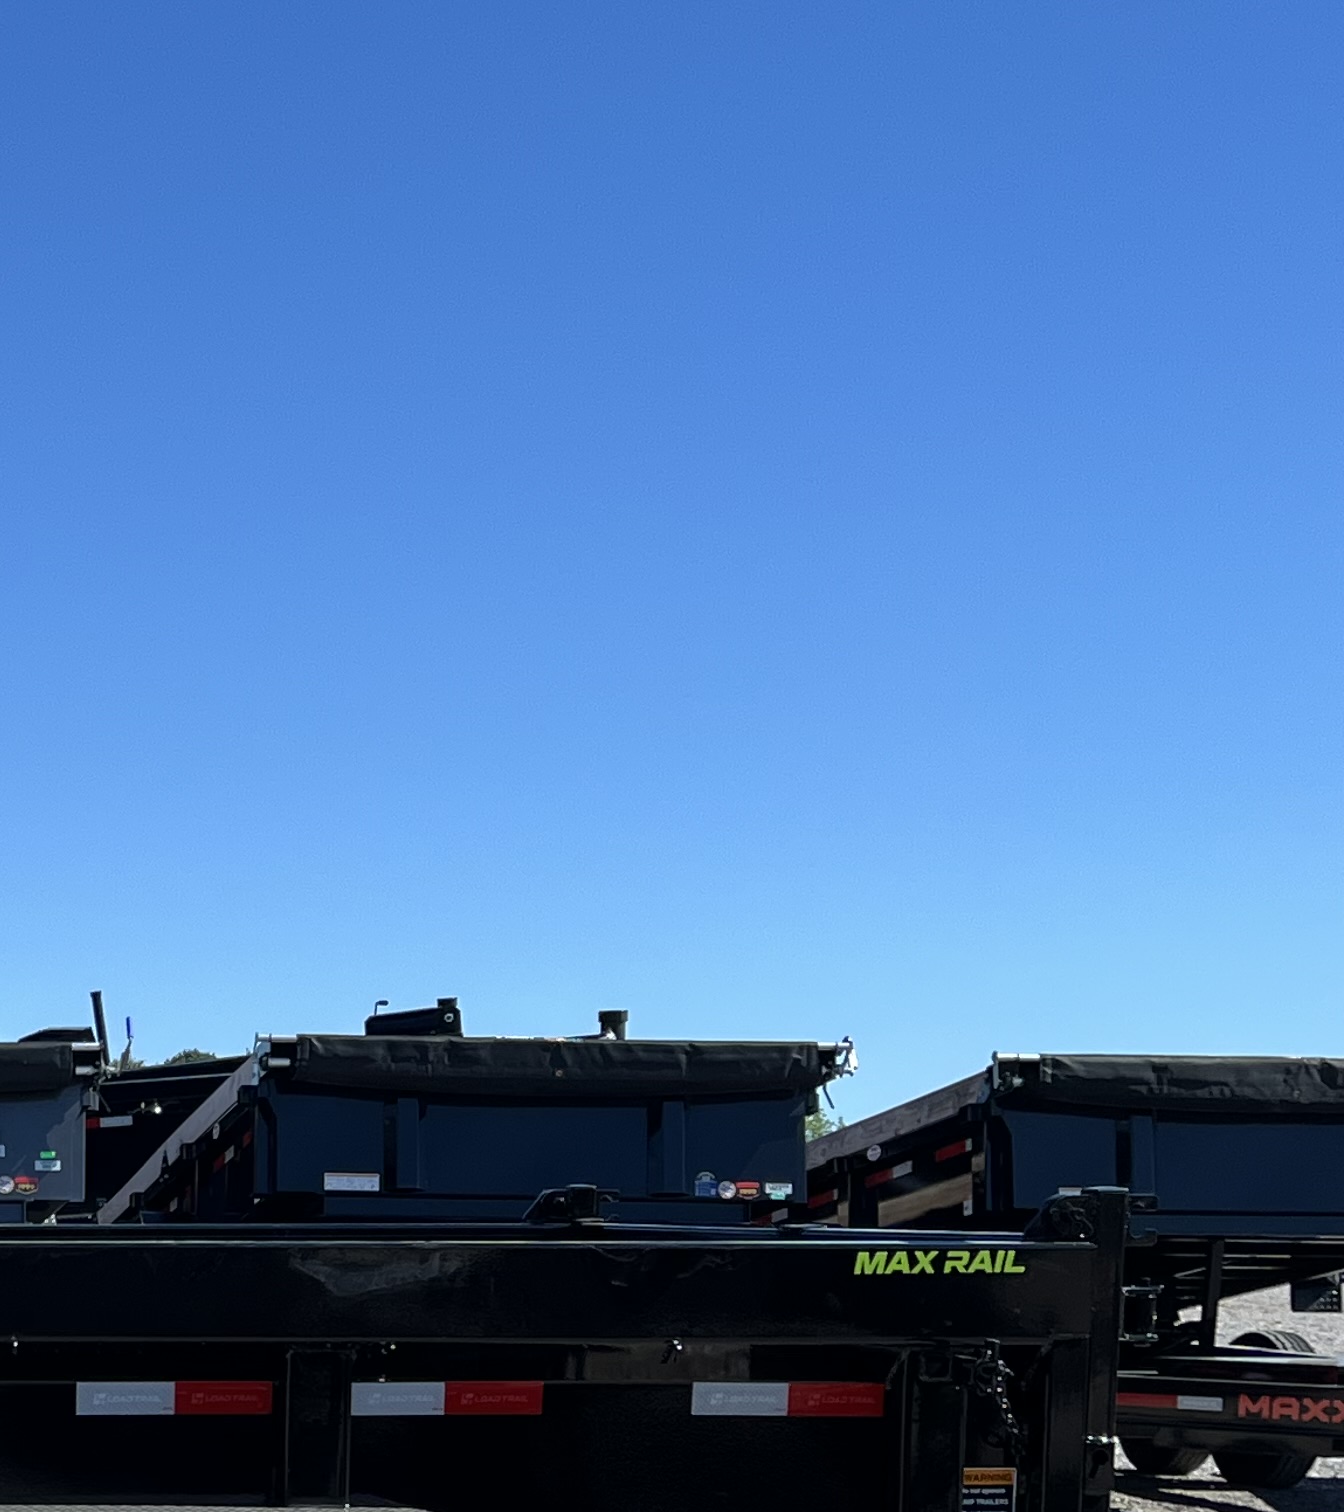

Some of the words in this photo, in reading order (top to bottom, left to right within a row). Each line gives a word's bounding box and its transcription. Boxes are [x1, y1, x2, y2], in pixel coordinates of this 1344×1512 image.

[854, 1250, 939, 1275] MAX
[943, 1250, 1026, 1274] RAIL
[964, 1473, 1013, 1482] WARNING
